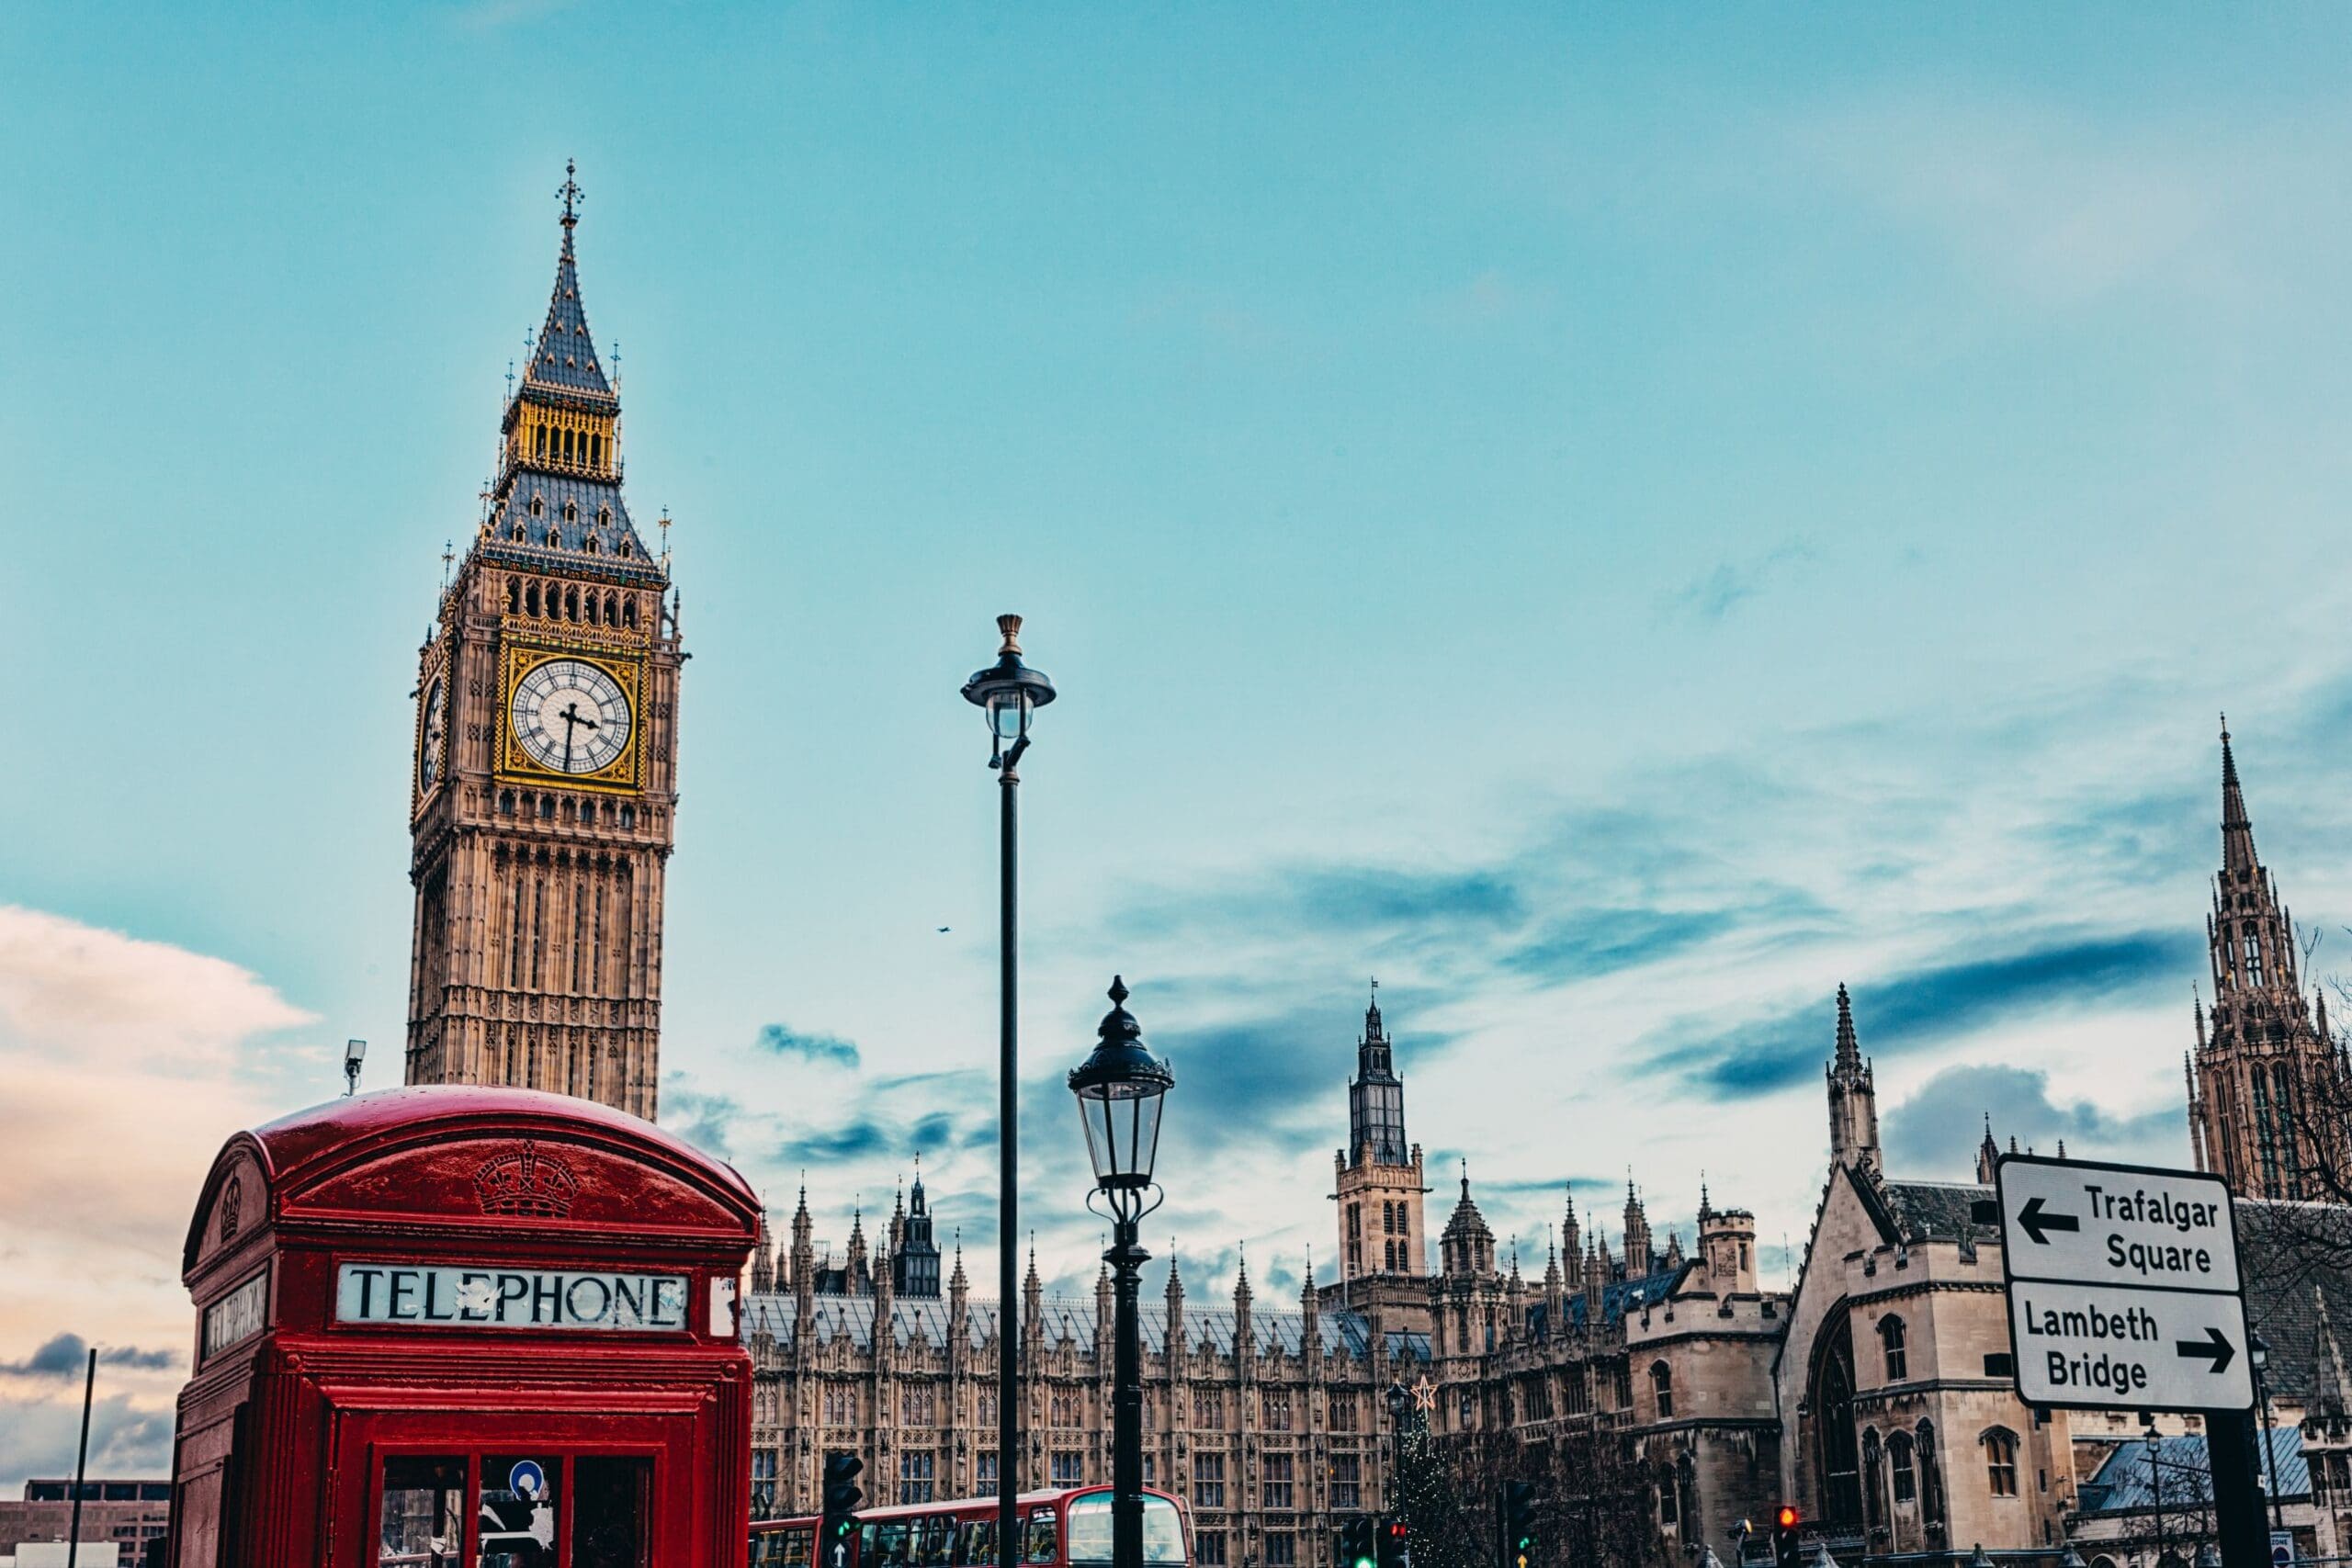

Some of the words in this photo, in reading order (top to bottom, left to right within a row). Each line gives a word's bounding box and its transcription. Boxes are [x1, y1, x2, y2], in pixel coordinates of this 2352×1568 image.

[2084, 1185, 2218, 1232] Trafalgar
[2107, 1233, 2211, 1275] Square
[349, 1269, 678, 1325] TELEPHONE
[2025, 1300, 2158, 1341] Lambeth
[2047, 1350, 2147, 1395] Bridge
